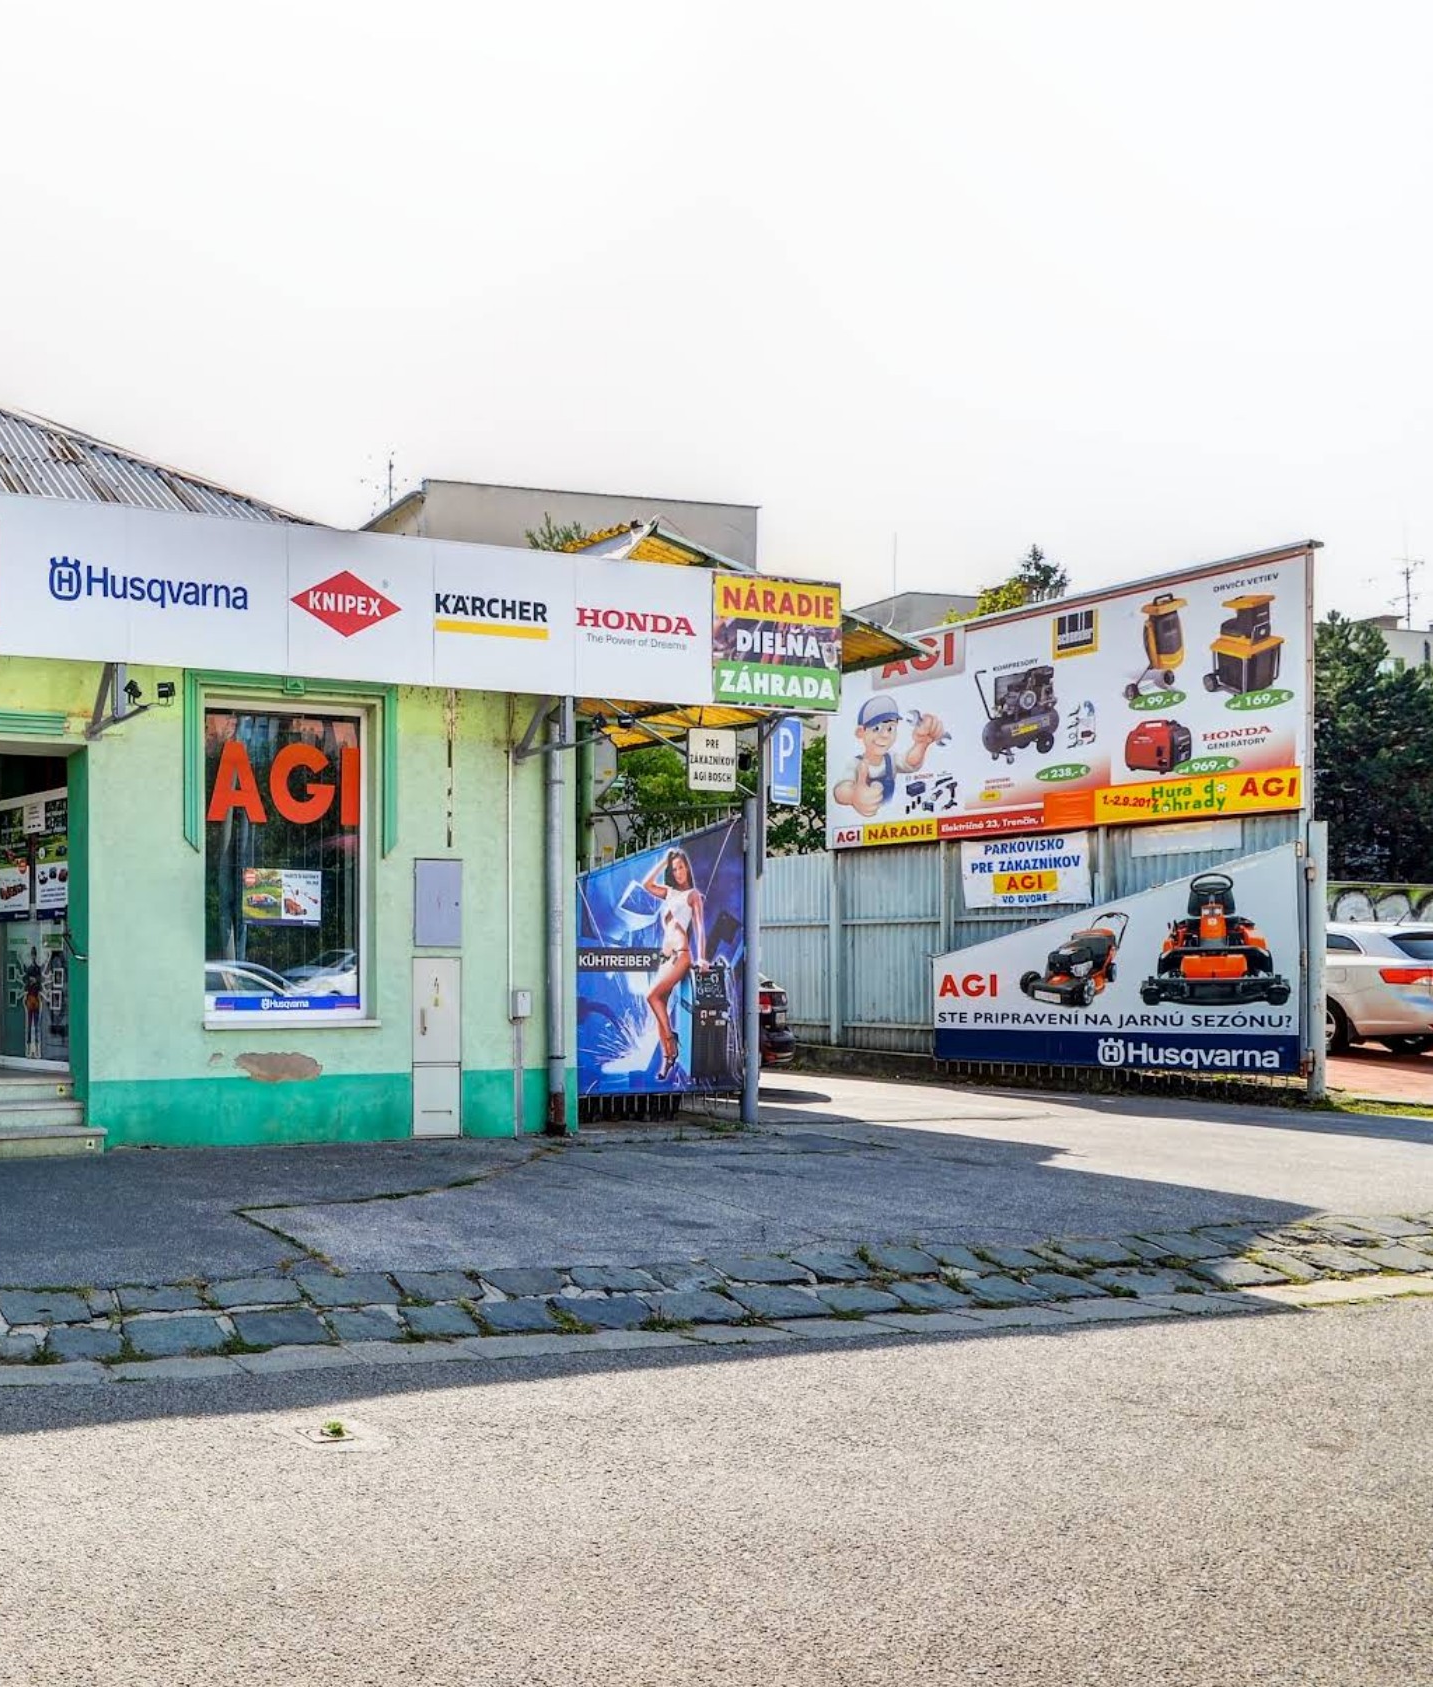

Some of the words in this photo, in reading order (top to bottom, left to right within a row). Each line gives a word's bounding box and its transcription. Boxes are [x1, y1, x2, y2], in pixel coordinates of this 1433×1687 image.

[87, 565, 249, 610] Husqvarna
[308, 590, 382, 617] KNIPEX
[435, 593, 548, 623] KÄRCHER
[722, 582, 834, 620] NÁRADIE
[576, 607, 697, 636] HONDA
[587, 632, 603, 643] The
[606, 635, 636, 646] Power
[638, 638, 648, 647] of
[651, 639, 687, 650] Dreams
[736, 628, 821, 659] DIELŇA
[720, 665, 836, 700] ZÁHRADA
[1172, 693, 1181, 701] €
[1202, 725, 1273, 741] HONDA
[705, 739, 719, 749] PRE
[779, 727, 794, 773] P
[690, 753, 735, 766] ZÁKAZNÍKOV
[206, 741, 360, 826] AGI
[693, 771, 706, 781] AGI
[708, 772, 732, 783] BOSCH
[1151, 783, 1192, 799] Hurá
[1240, 777, 1296, 797] AGI
[837, 830, 860, 843] AGI
[868, 822, 933, 841] NÁRADIE
[984, 839, 1064, 855] PARKOVISKO
[971, 862, 994, 874] PRE
[999, 854, 1081, 872] ZÁKAZNÍKOV
[1007, 874, 1043, 890] AGI
[1002, 895, 1014, 904] VO
[1018, 893, 1048, 903] DVORE
[579, 952, 651, 967] KÜHTREIBER
[939, 974, 998, 998] AGI
[270, 999, 309, 1010] Husqvarna
[938, 1011, 968, 1024] STE
[974, 1009, 1079, 1026] PRIPRAVENÍ
[1085, 1013, 1113, 1026] NA
[1117, 1010, 1183, 1029] JARNÚ
[1191, 1010, 1293, 1029] SEZÓNU?
[1128, 1042, 1280, 1069] Husqvarna
